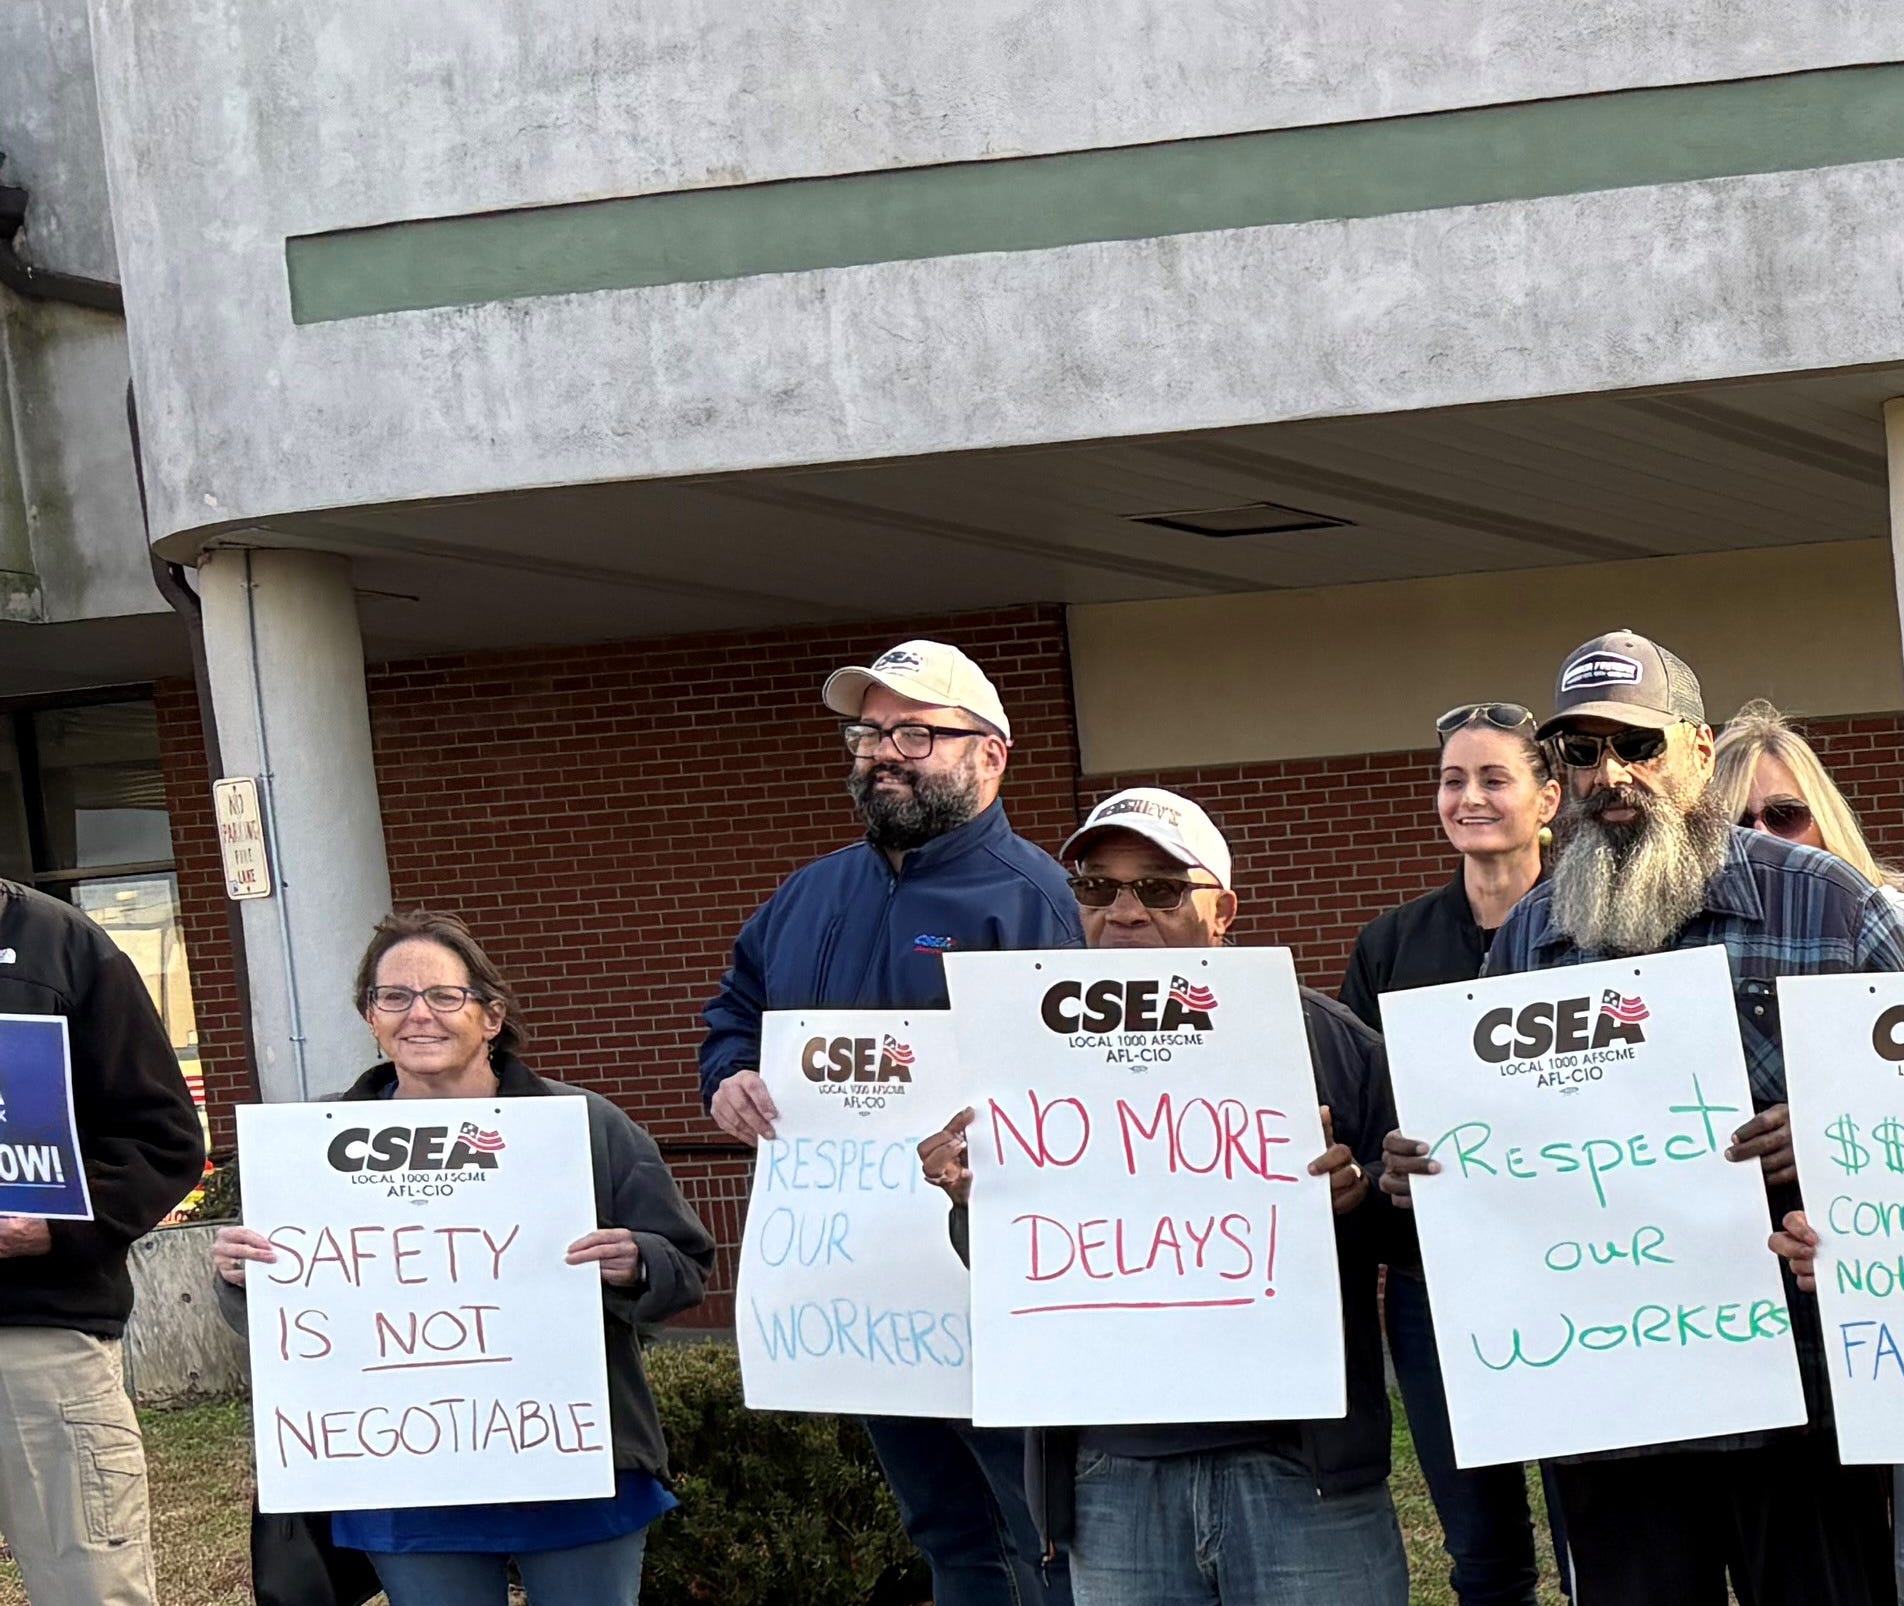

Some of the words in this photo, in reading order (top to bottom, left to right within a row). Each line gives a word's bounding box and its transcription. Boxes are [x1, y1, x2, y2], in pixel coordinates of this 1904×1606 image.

[1041, 978, 1216, 1034] CSEA
[1473, 992, 1648, 1063] CSEA
[802, 1036, 914, 1082] CSEA
[1069, 1036, 1113, 1048] LOCAL
[1117, 1035, 1147, 1046] 1000
[1151, 1034, 1204, 1046] AFSCME
[1106, 1048, 1172, 1063] AFL-CIO
[1500, 1060, 1543, 1077] LOCAL
[1550, 1055, 1578, 1070] 1000
[1582, 1047, 1635, 1065] AFSCME
[1536, 1066, 1603, 1088] AFL-CIO
[327, 1124, 501, 1172] CSEA
[988, 1089, 1090, 1168] NO
[1116, 1092, 1299, 1183] MORE
[0, 1144, 64, 1182] OW!
[351, 1174, 395, 1184] LOCAL
[402, 1173, 429, 1183] 1000
[767, 1137, 921, 1193] RESPECT
[387, 1184, 453, 1197] AFL-CIO
[267, 1225, 519, 1288] SAFETY
[760, 1207, 853, 1267] OUR
[1011, 1204, 1277, 1297] DELAYS!
[279, 1308, 331, 1361] IS
[376, 1306, 500, 1355] NOT
[275, 1400, 603, 1468] NEGOTIABLE
